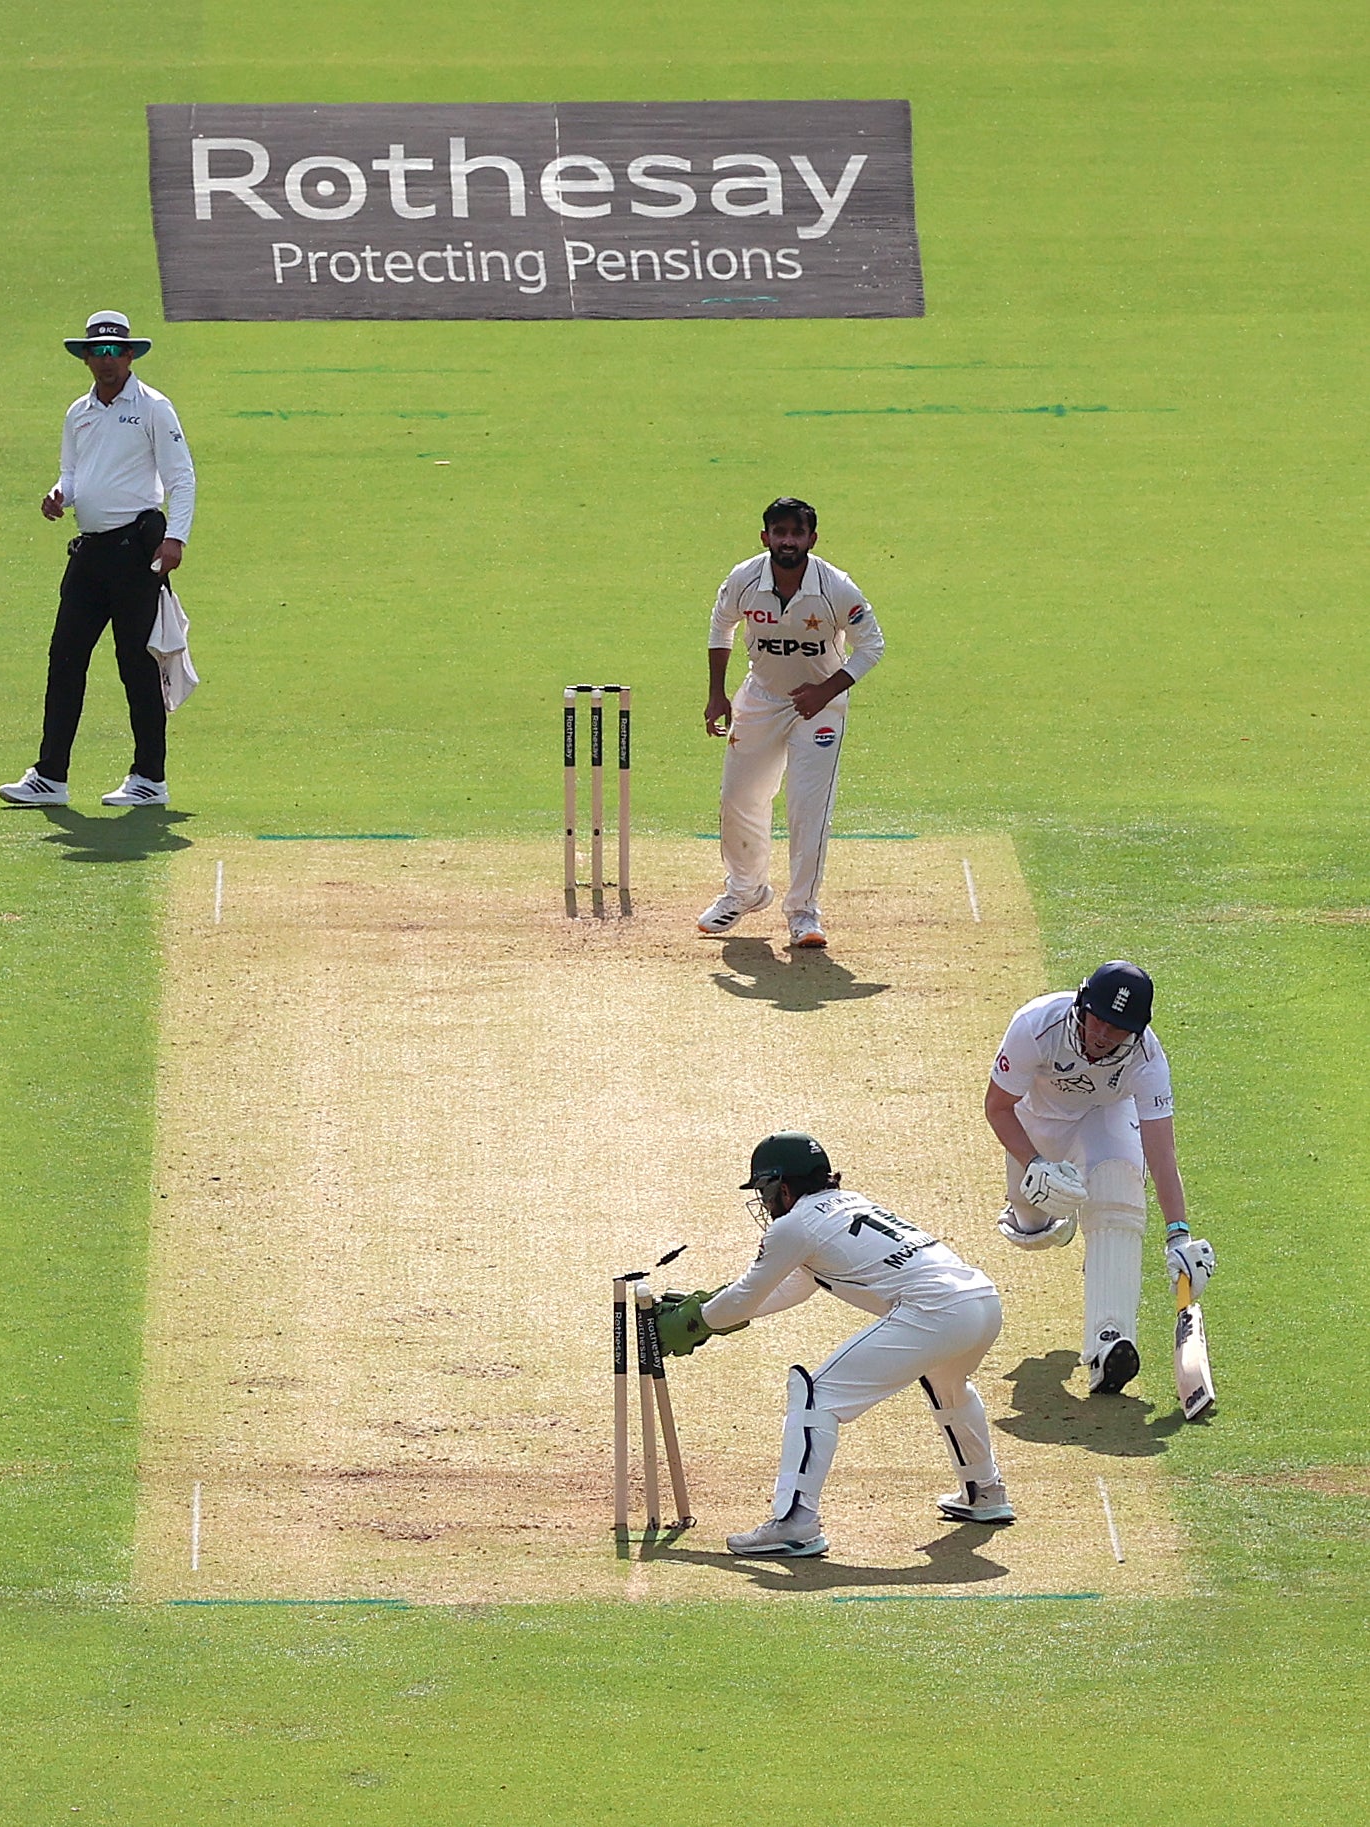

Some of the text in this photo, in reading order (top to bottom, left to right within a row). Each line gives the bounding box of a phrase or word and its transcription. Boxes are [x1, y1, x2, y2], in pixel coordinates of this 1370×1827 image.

[191, 136, 869, 240] Rothesay
[272, 239, 803, 293] Protecting Pensions
[107, 326, 118, 334] ICC
[743, 610, 779, 624] TCL
[757, 638, 826, 657] PEPSI
[566, 714, 574, 759] Rothesay
[620, 717, 628, 762] Rothesay
[614, 1311, 623, 1365] Rothesay
